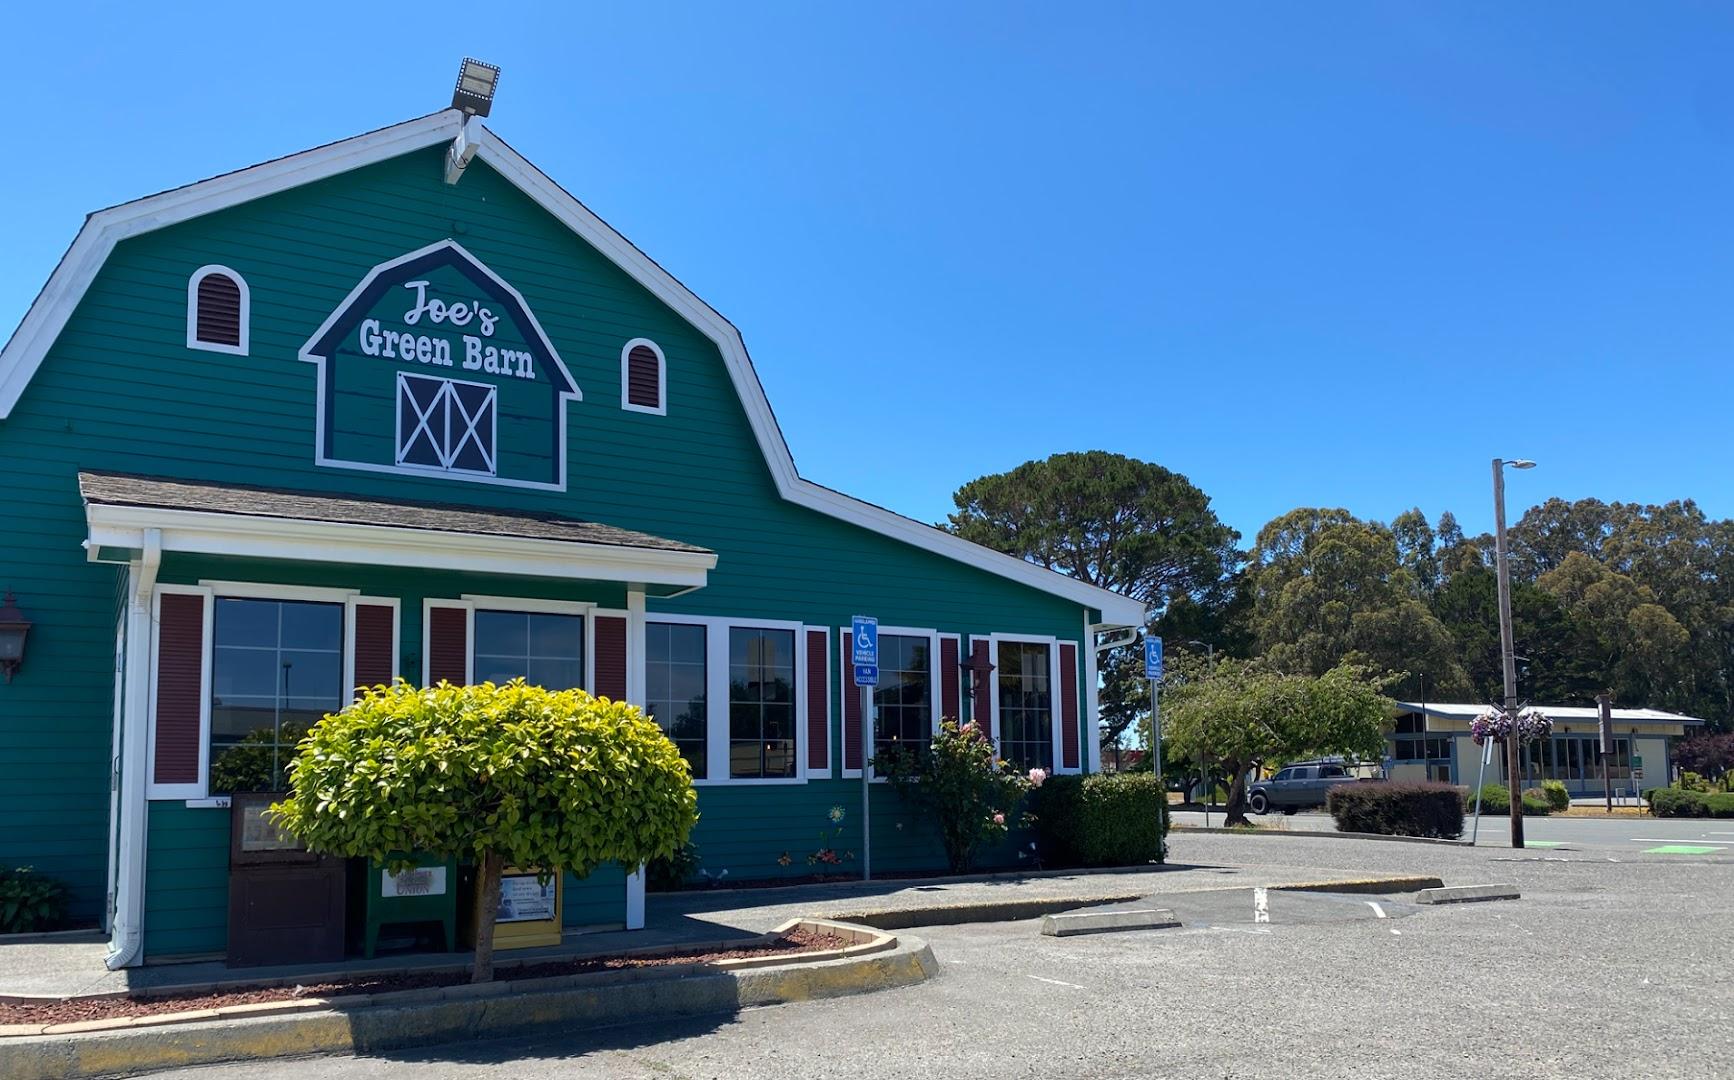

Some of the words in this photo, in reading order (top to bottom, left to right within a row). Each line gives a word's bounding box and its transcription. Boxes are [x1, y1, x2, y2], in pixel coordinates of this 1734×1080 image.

[403, 280, 499, 336] Joe's
[359, 318, 453, 367] Green
[462, 334, 536, 379] Barn
[862, 667, 872, 675] VAN
